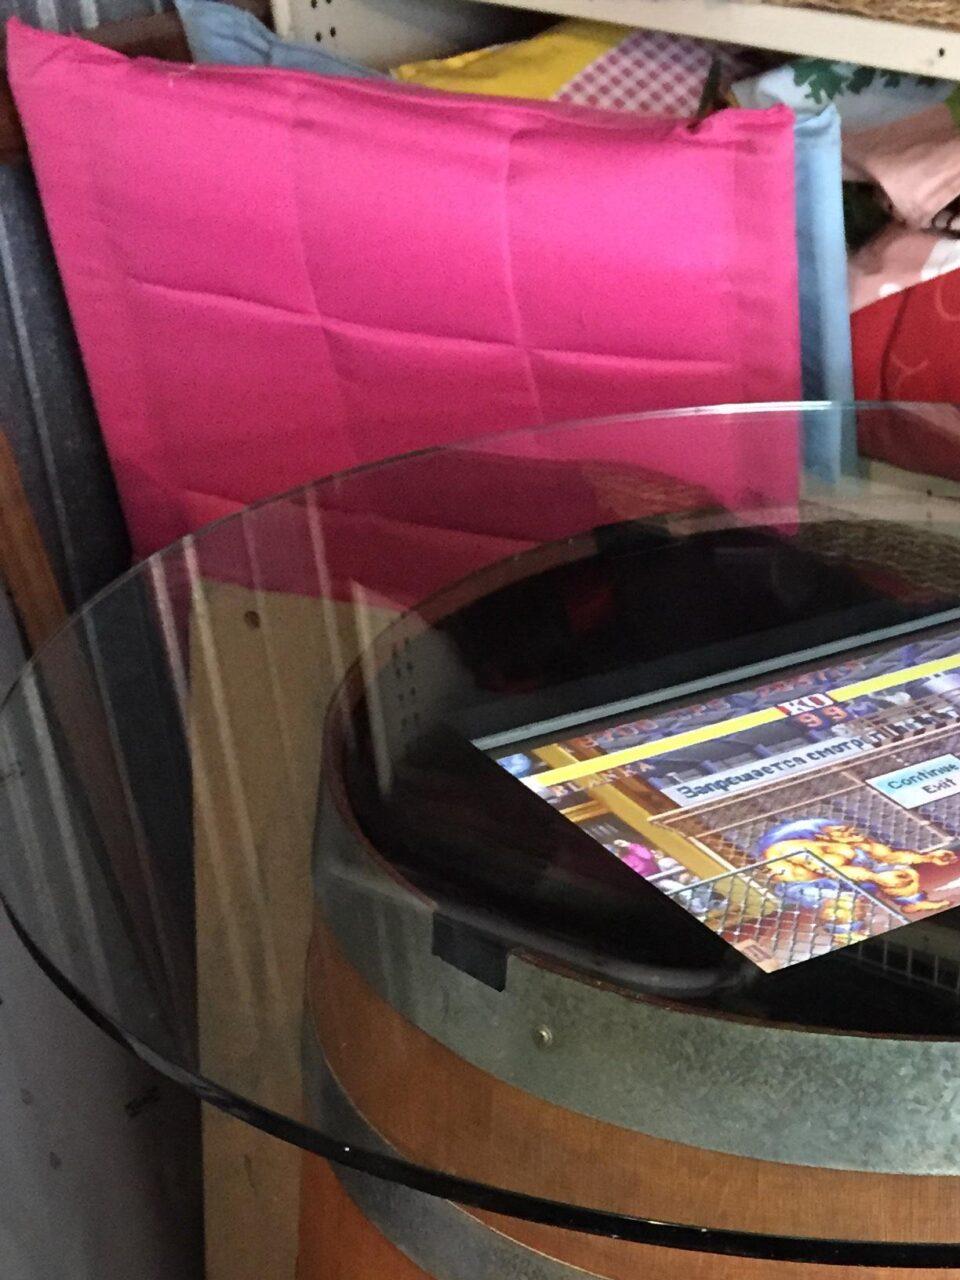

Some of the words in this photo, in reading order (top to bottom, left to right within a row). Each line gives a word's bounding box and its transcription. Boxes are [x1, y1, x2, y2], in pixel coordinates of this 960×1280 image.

[785, 693, 835, 716] KO
[887, 762, 960, 791] Continue
[923, 778, 956, 795] Exit
